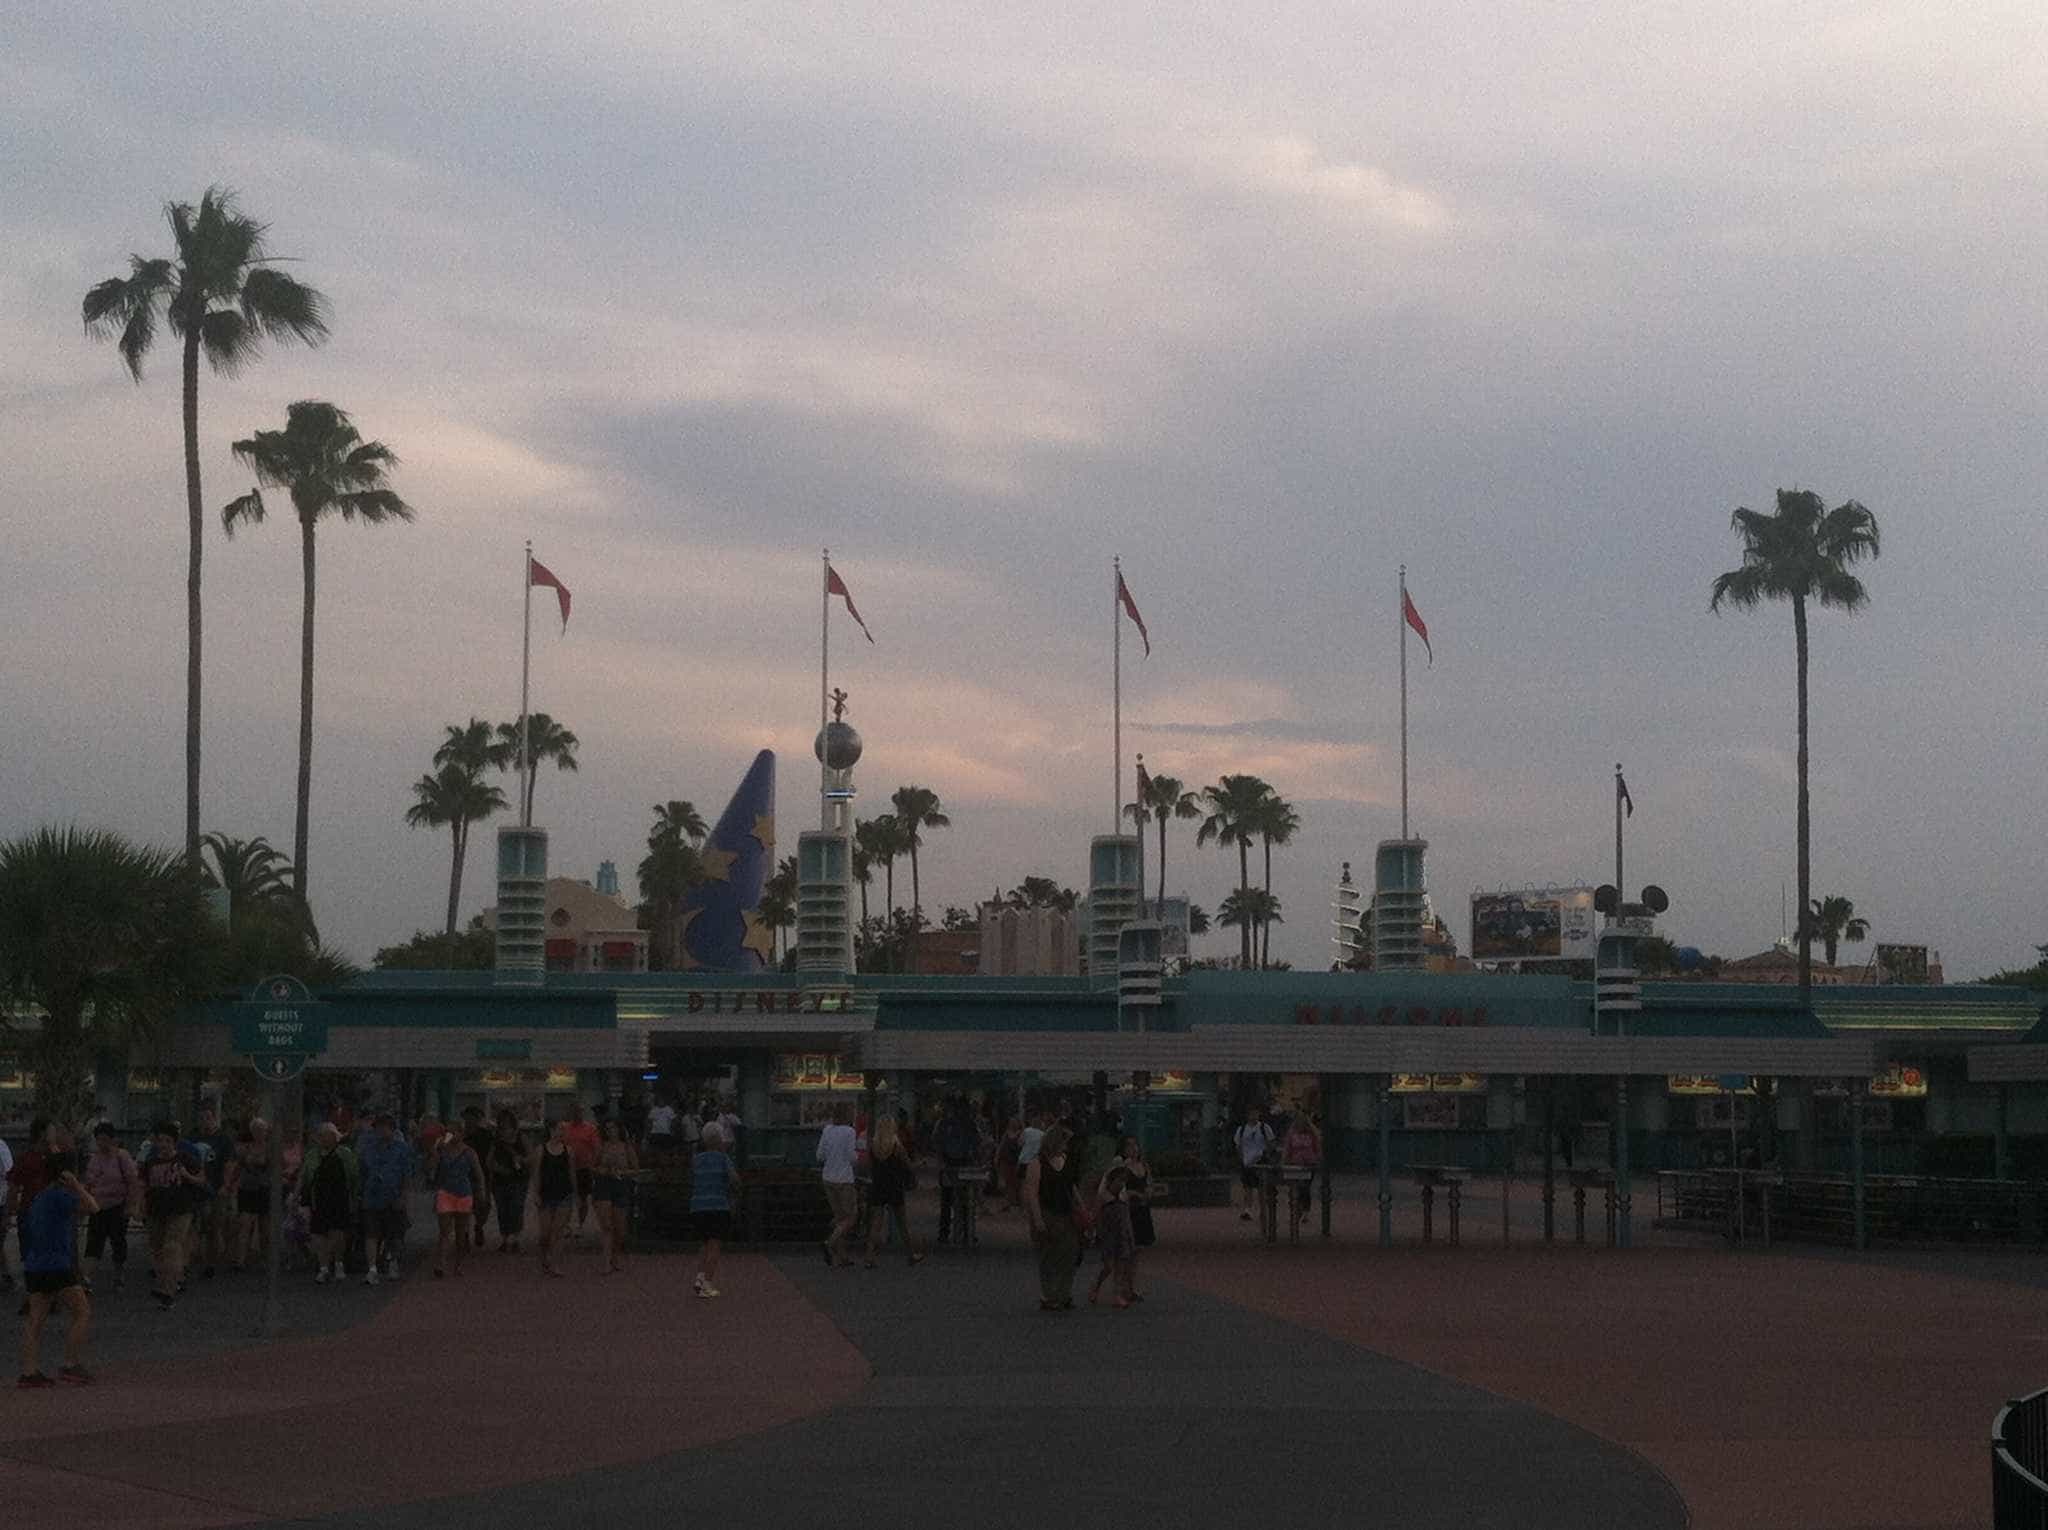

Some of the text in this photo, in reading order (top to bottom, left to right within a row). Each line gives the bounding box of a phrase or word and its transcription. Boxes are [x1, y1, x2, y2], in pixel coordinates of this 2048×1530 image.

[263, 1010, 299, 1020] GUESTS
[258, 1022, 304, 1033] WITHOUT
[268, 1035, 293, 1045] BAGS
